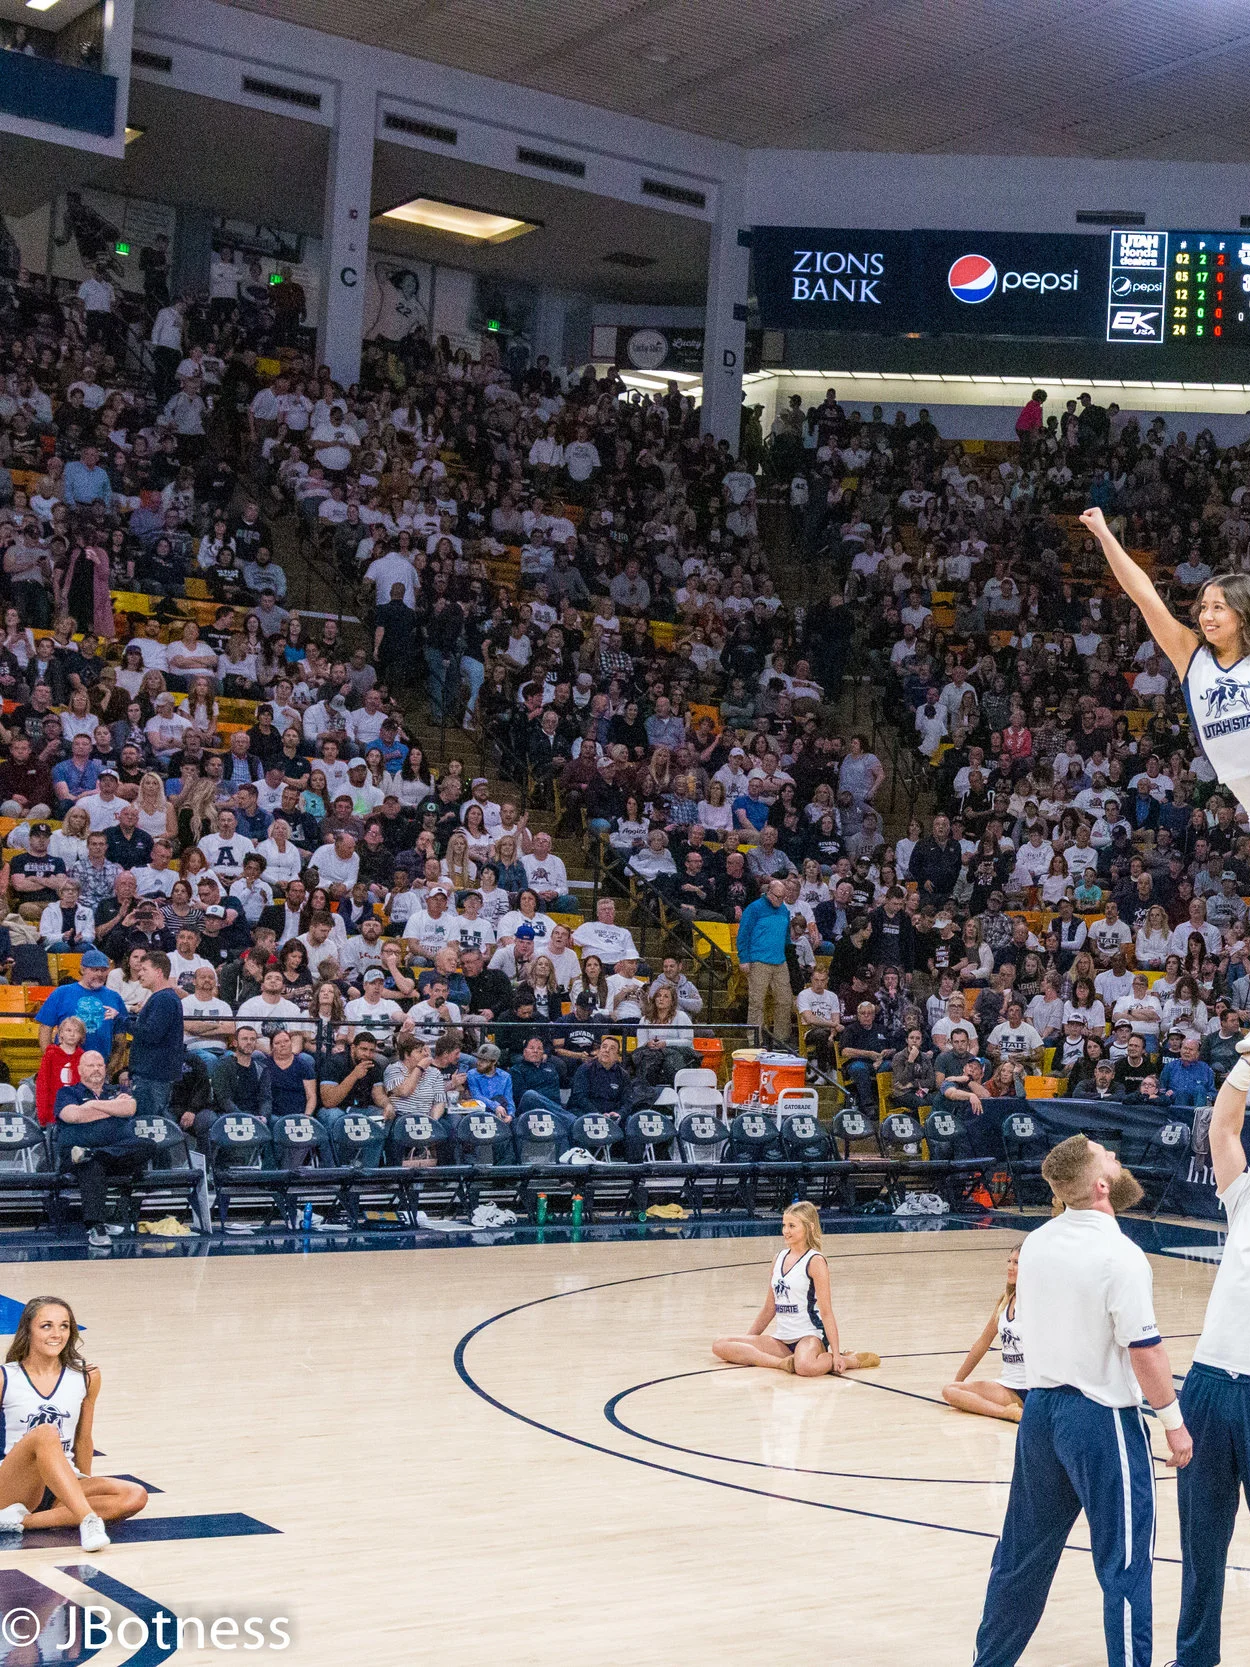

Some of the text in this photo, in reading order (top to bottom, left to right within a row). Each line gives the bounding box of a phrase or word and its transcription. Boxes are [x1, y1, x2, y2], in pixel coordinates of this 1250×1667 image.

[1121, 235, 1158, 248] UTAH
[1199, 242, 1205, 250] P
[1219, 242, 1225, 250] F
[1120, 248, 1158, 258] Honda
[1176, 253, 1225, 265] 02 2 2
[793, 251, 884, 275] ZIONS
[1120, 257, 1157, 266] dealers
[340, 267, 357, 287] C
[1002, 269, 1079, 294] pepsi
[1175, 271, 1224, 283] 05 17 0
[792, 277, 881, 304] BANK
[1132, 282, 1162, 292] pepsi
[1175, 289, 1222, 300] 12 2 1
[395, 303, 412, 317] 22
[1173, 307, 1222, 319] 22 0 0
[1238, 312, 1244, 321] 0
[1173, 325, 1222, 337] 24 5 0
[723, 350, 736, 367] D
[1203, 721, 1232, 739] UTAH
[214, 846, 239, 867] A
[569, 1030, 595, 1041] NEVADA
[999, 1042, 1027, 1050] STATE
[761, 1071, 768, 1085] G
[779, 1304, 798, 1314] STATE
[1008, 1352, 1024, 1364] STAT
